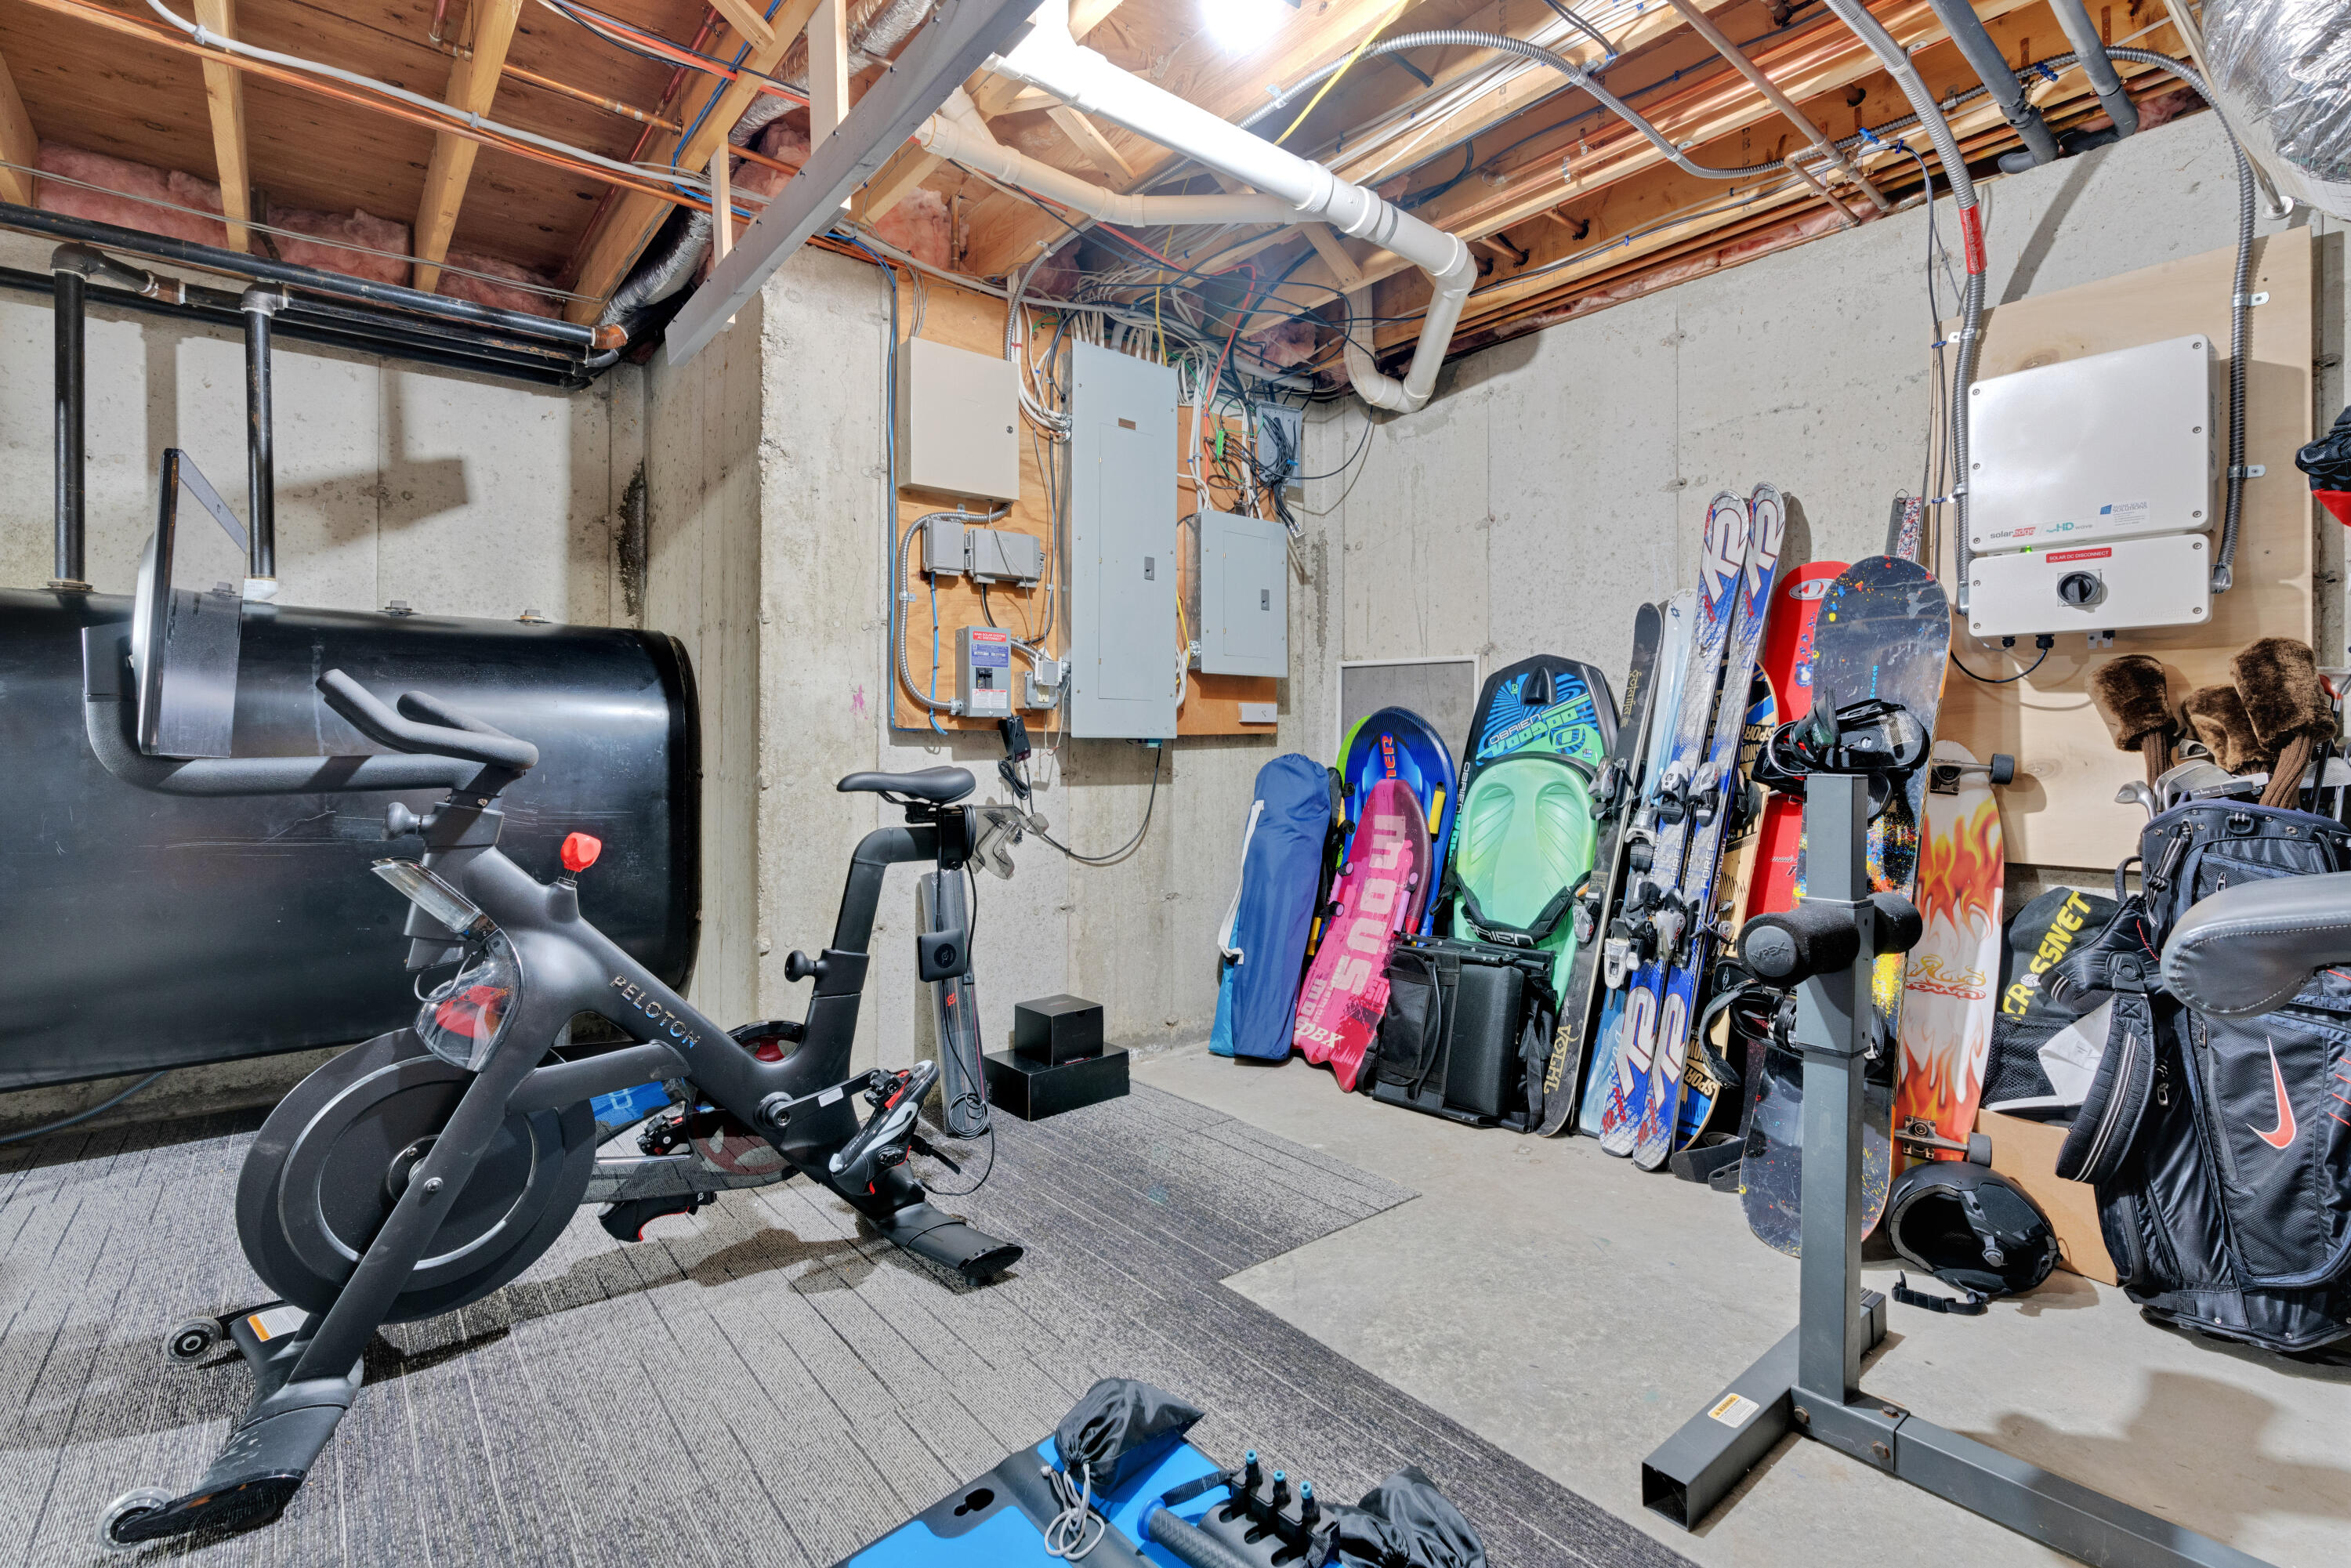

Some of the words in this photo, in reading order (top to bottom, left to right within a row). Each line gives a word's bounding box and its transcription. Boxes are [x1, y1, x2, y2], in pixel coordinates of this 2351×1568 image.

[2074, 550, 2110, 559] DISCONNECT
[1700, 840, 1716, 889] FORCE
[609, 973, 701, 1049] PELOTON
[1295, 1021, 1346, 1048] DBX
